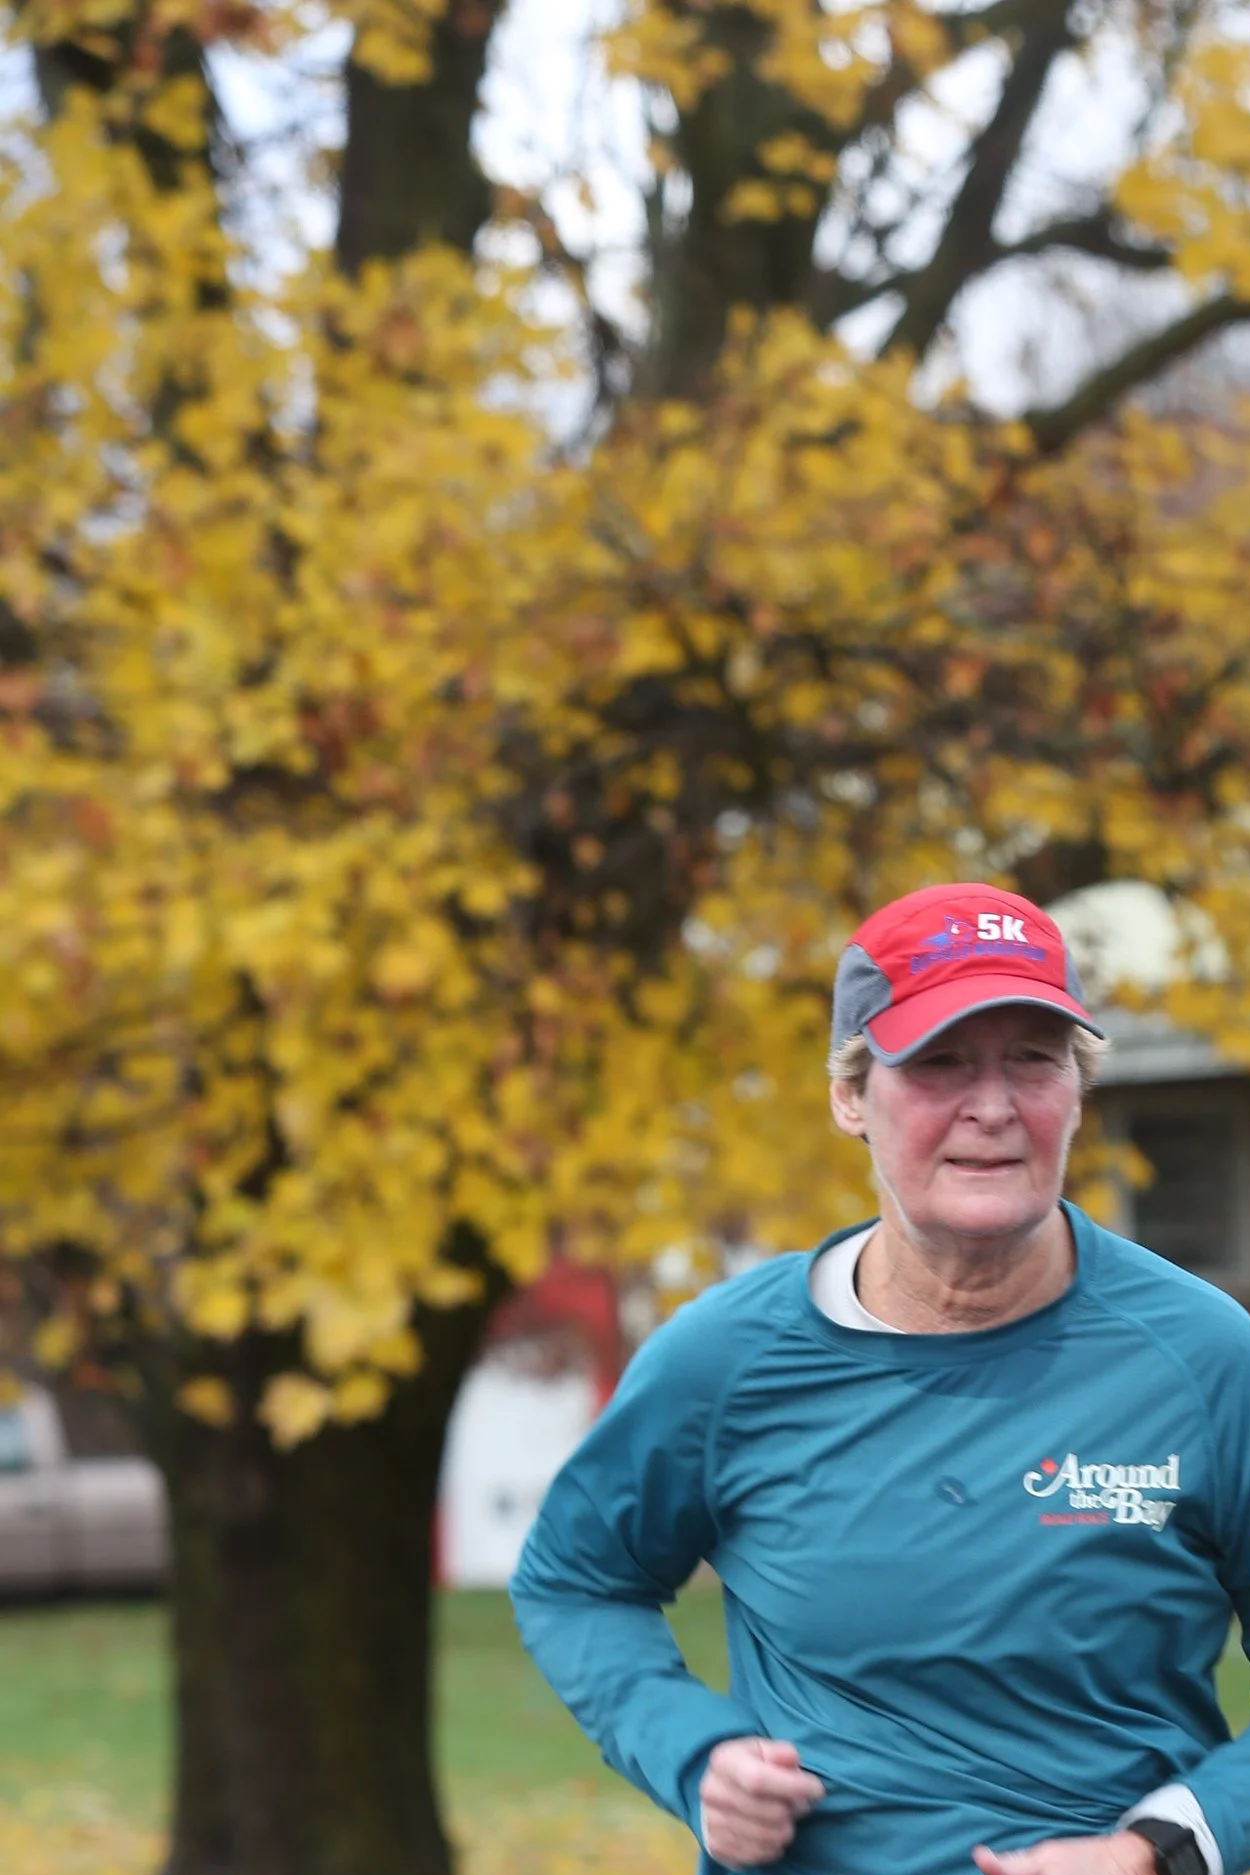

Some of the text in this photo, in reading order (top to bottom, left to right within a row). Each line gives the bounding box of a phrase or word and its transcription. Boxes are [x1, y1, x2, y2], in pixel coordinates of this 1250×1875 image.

[976, 912, 1029, 944] 5K
[1023, 1452, 1181, 1498] Around
[1068, 1489, 1101, 1509] the
[1099, 1487, 1177, 1533] Bay
